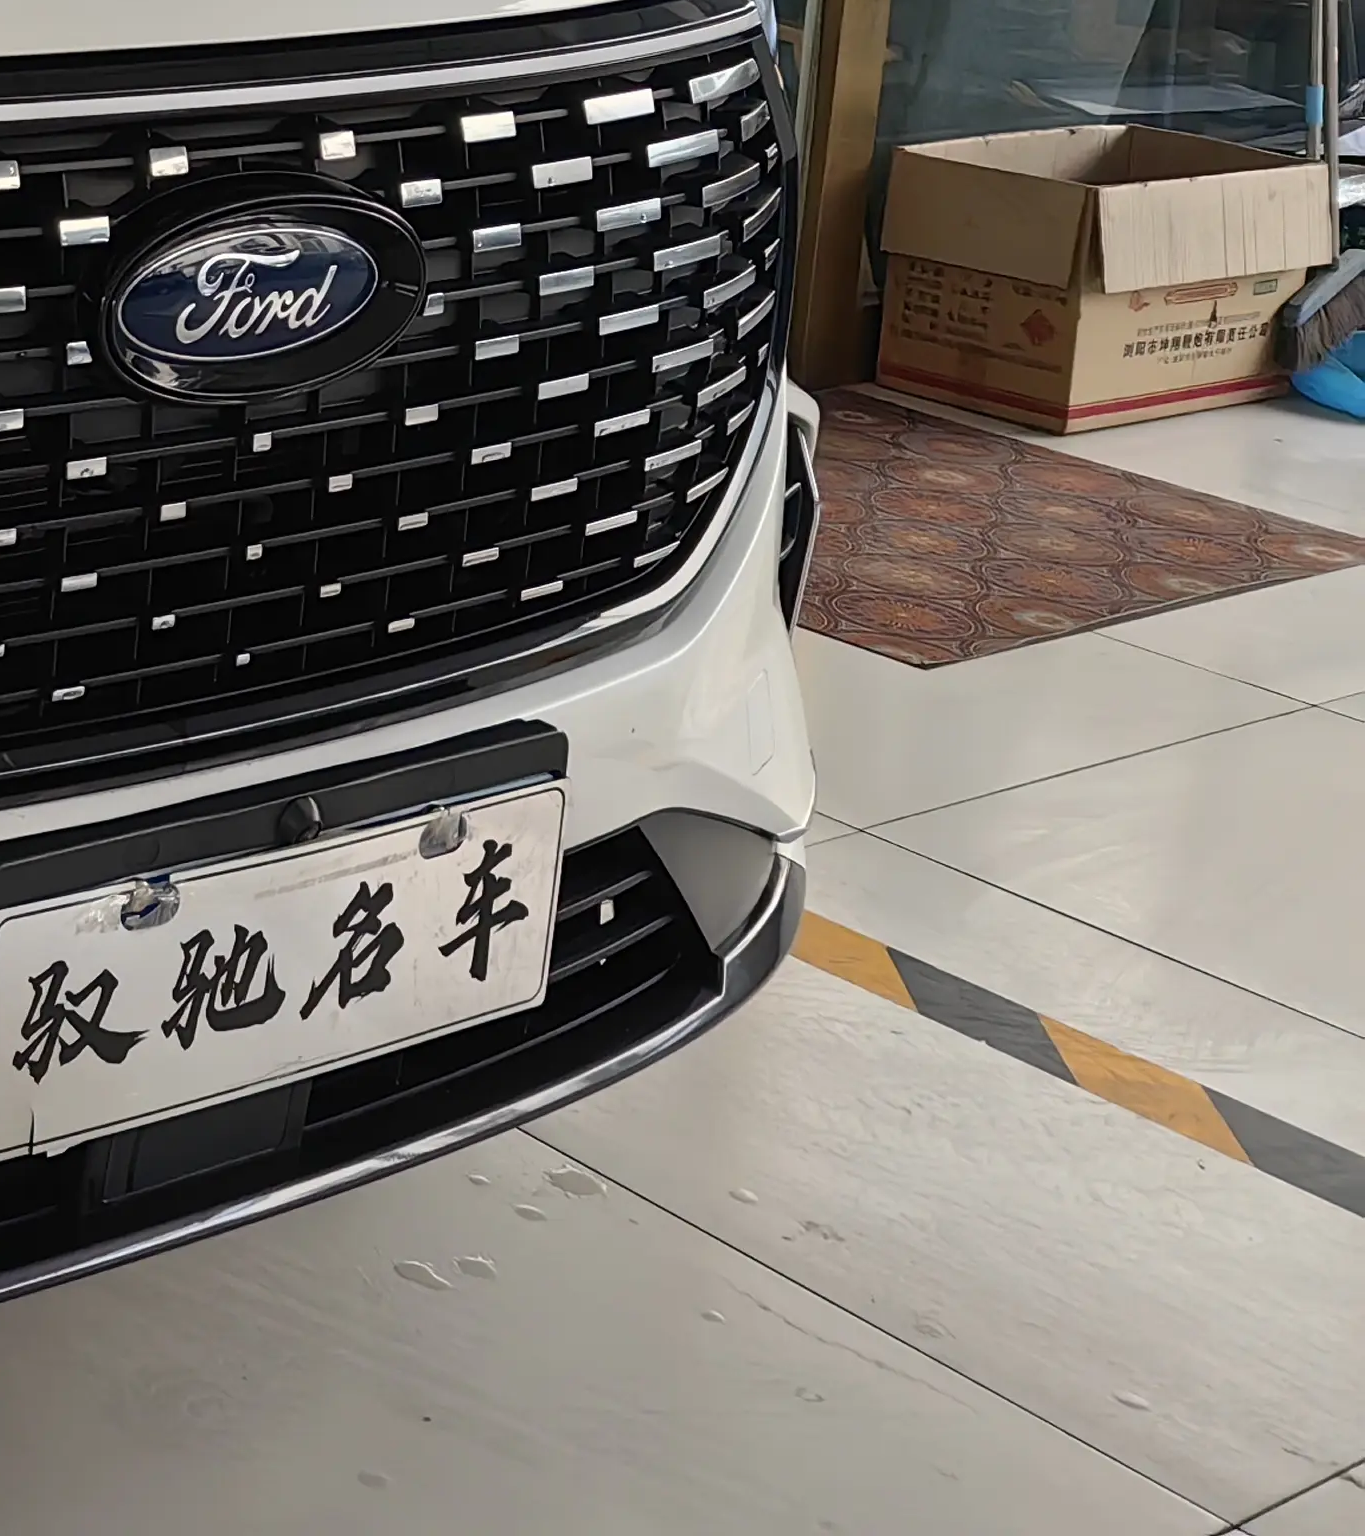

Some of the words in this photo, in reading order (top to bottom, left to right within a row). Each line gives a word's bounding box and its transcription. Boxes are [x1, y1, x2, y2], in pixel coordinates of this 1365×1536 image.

[175, 249, 337, 344] Ford
[12, 838, 530, 1083] 驭驰名车
